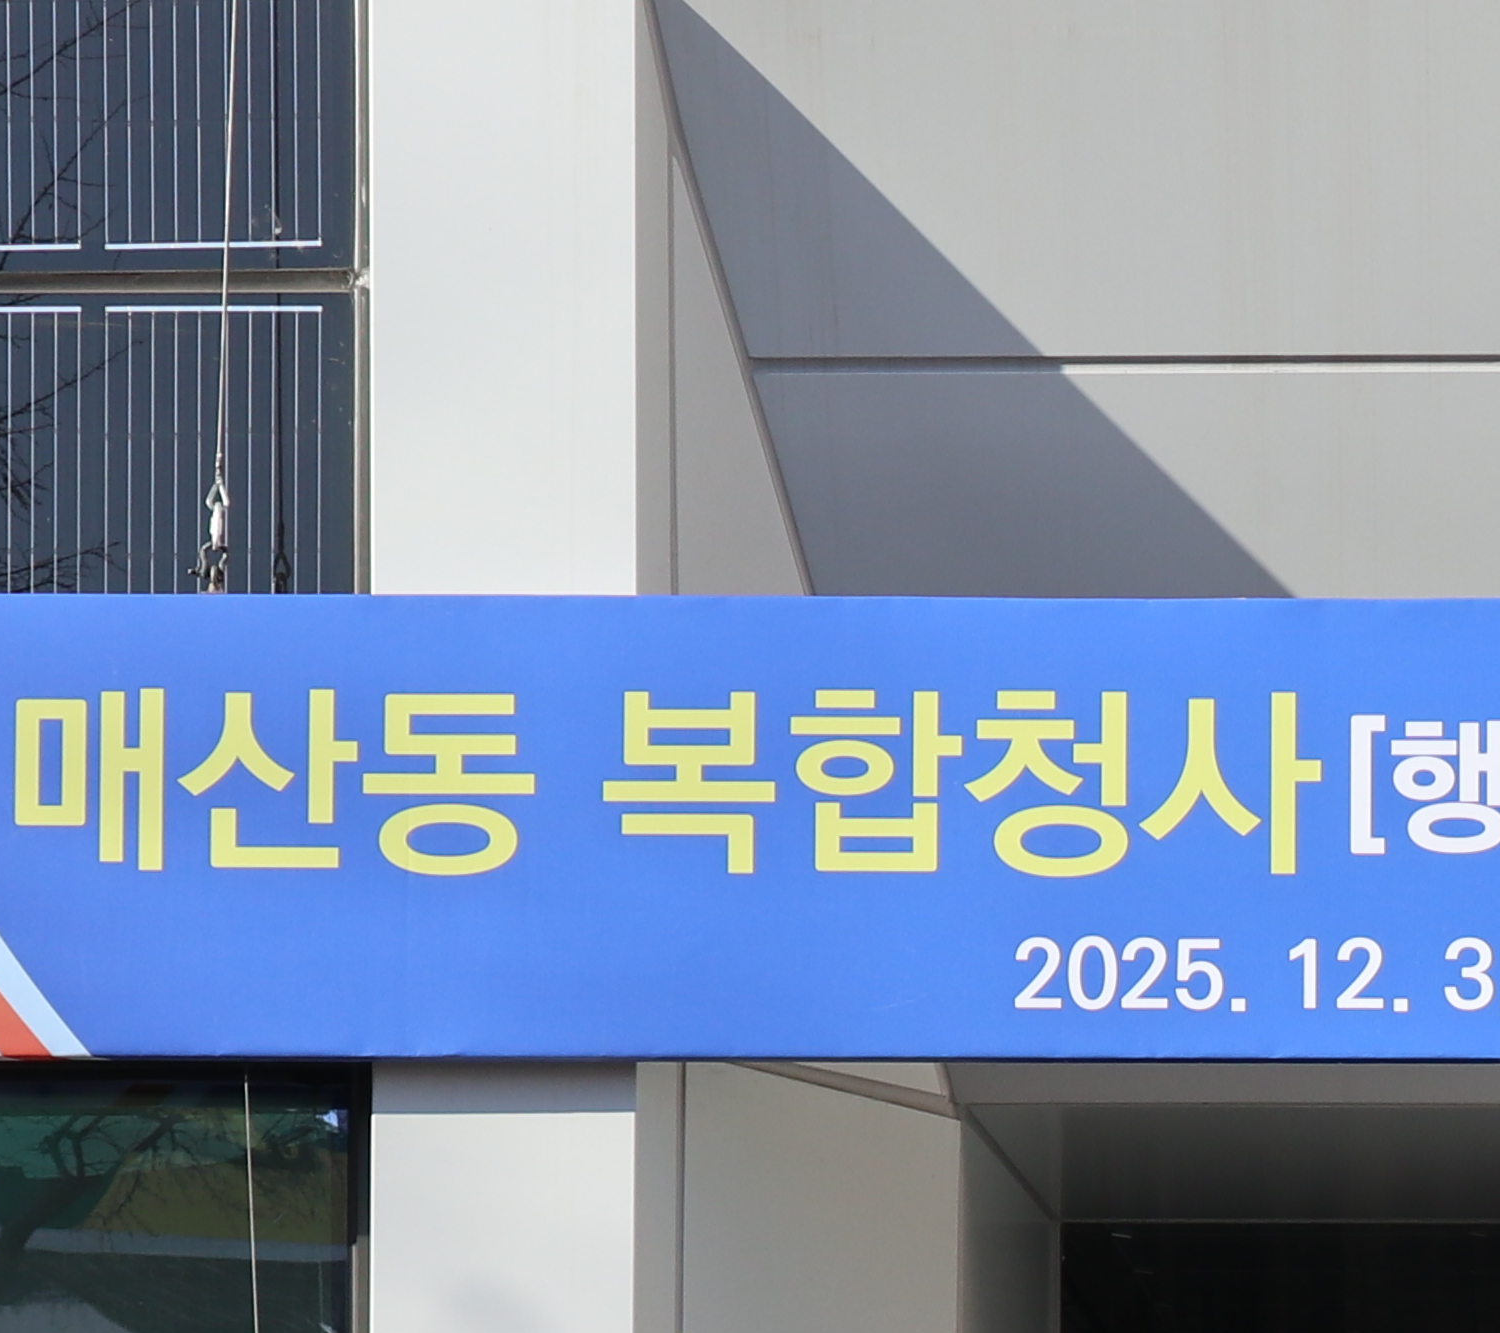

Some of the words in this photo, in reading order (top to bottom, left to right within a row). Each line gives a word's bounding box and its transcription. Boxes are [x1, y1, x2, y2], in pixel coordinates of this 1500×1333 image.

[14, 687, 536, 877] 매산동
[1013, 934, 1247, 1013] 2025.
[1288, 936, 1410, 1013] 12.
